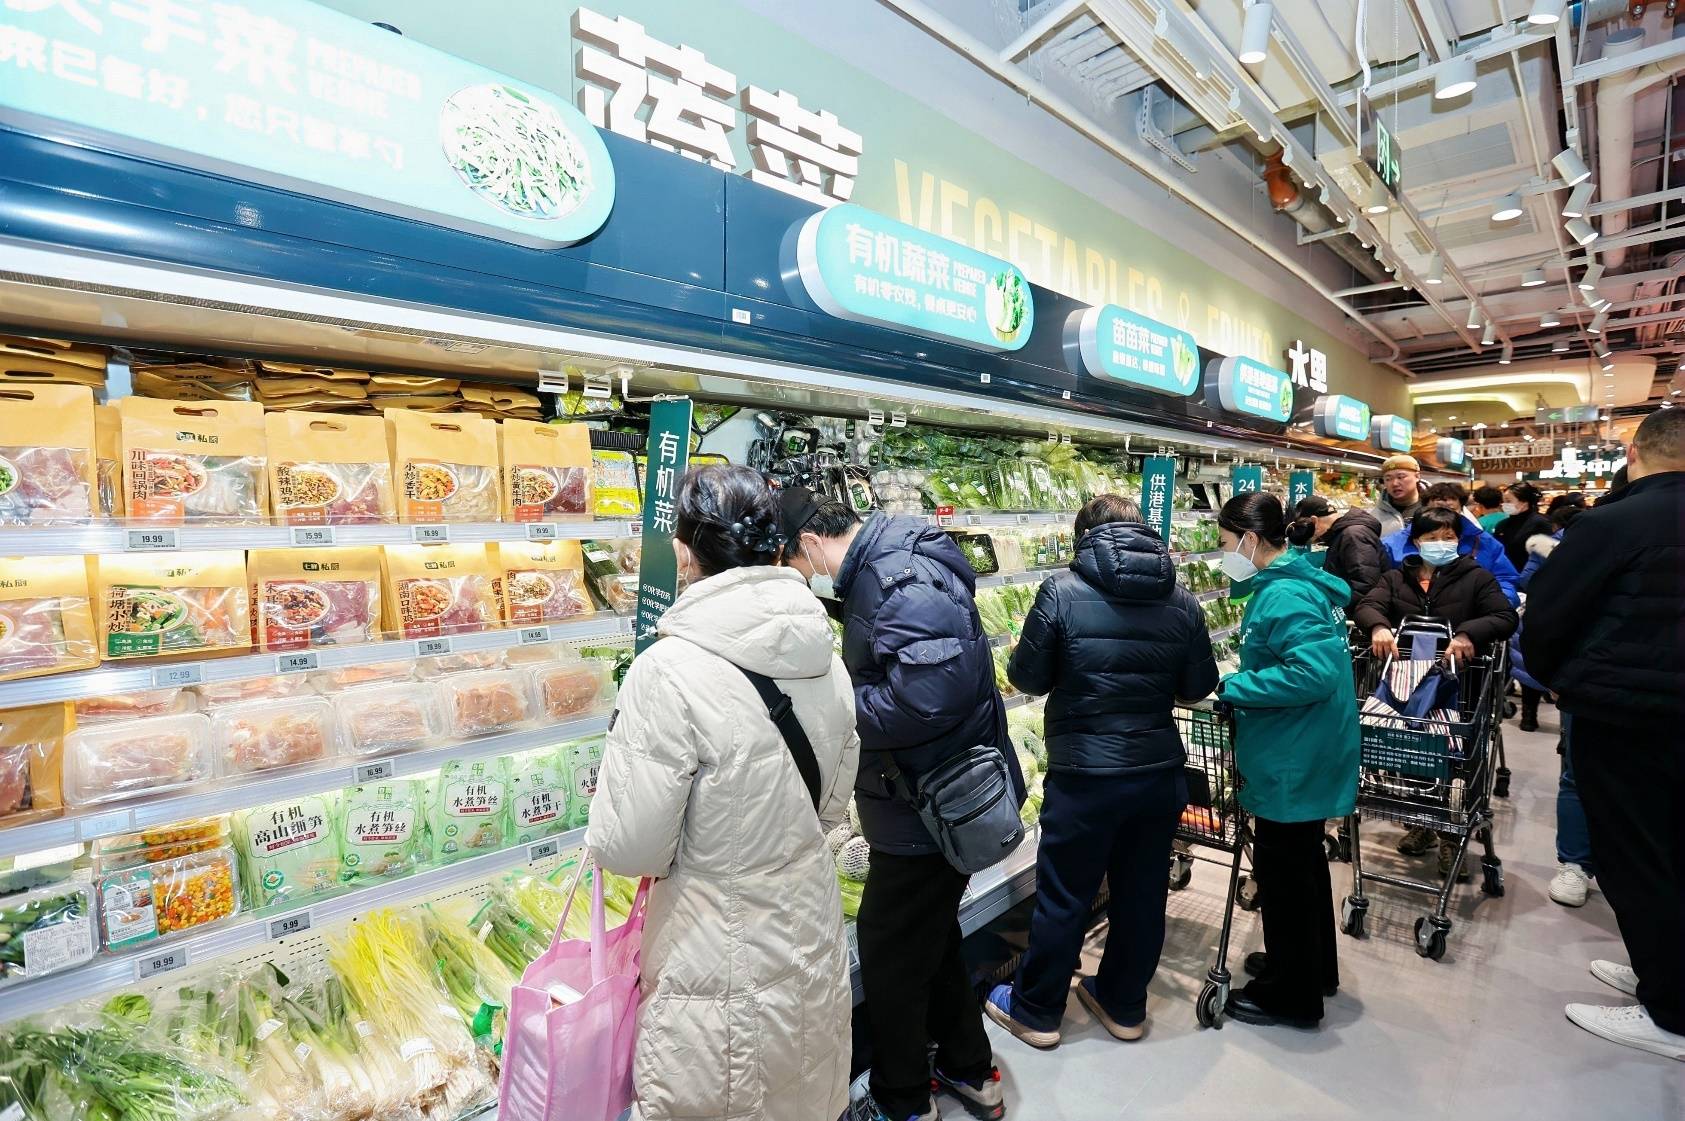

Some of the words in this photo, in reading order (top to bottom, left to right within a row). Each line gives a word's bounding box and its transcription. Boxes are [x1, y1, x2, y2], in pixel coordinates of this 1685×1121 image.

[572, 7, 862, 208] 蔬菜
[846, 223, 950, 291] 有机蔬菜
[1112, 317, 1151, 354] 苗苗菜
[131, 450, 148, 501] 川味回锅肉
[404, 462, 416, 499] 小炒香干
[652, 431, 681, 534] 有机菜
[1238, 479, 1256, 493] 24
[141, 535, 163, 543] 19.99
[305, 532, 323, 540] 15.99
[109, 586, 129, 633] 荷塘小炒
[398, 582, 414, 623] 湖南口味鸡
[289, 658, 308, 667] 14.99
[168, 671, 191, 681] 12.99
[590, 765, 601, 777] 有
[466, 784, 488, 796] 有机
[453, 796, 498, 808] 水煮笋丝
[532, 792, 551, 806] 有机
[271, 806, 304, 825] 有机
[370, 810, 396, 823] 有机
[522, 800, 562, 819] 水煮笋干
[255, 815, 324, 847] 高山细笋
[355, 822, 406, 835] 水煮笋丝
[538, 846, 550, 855] 9.99
[282, 919, 300, 931] 9.99
[152, 956, 175, 970] 19.99
